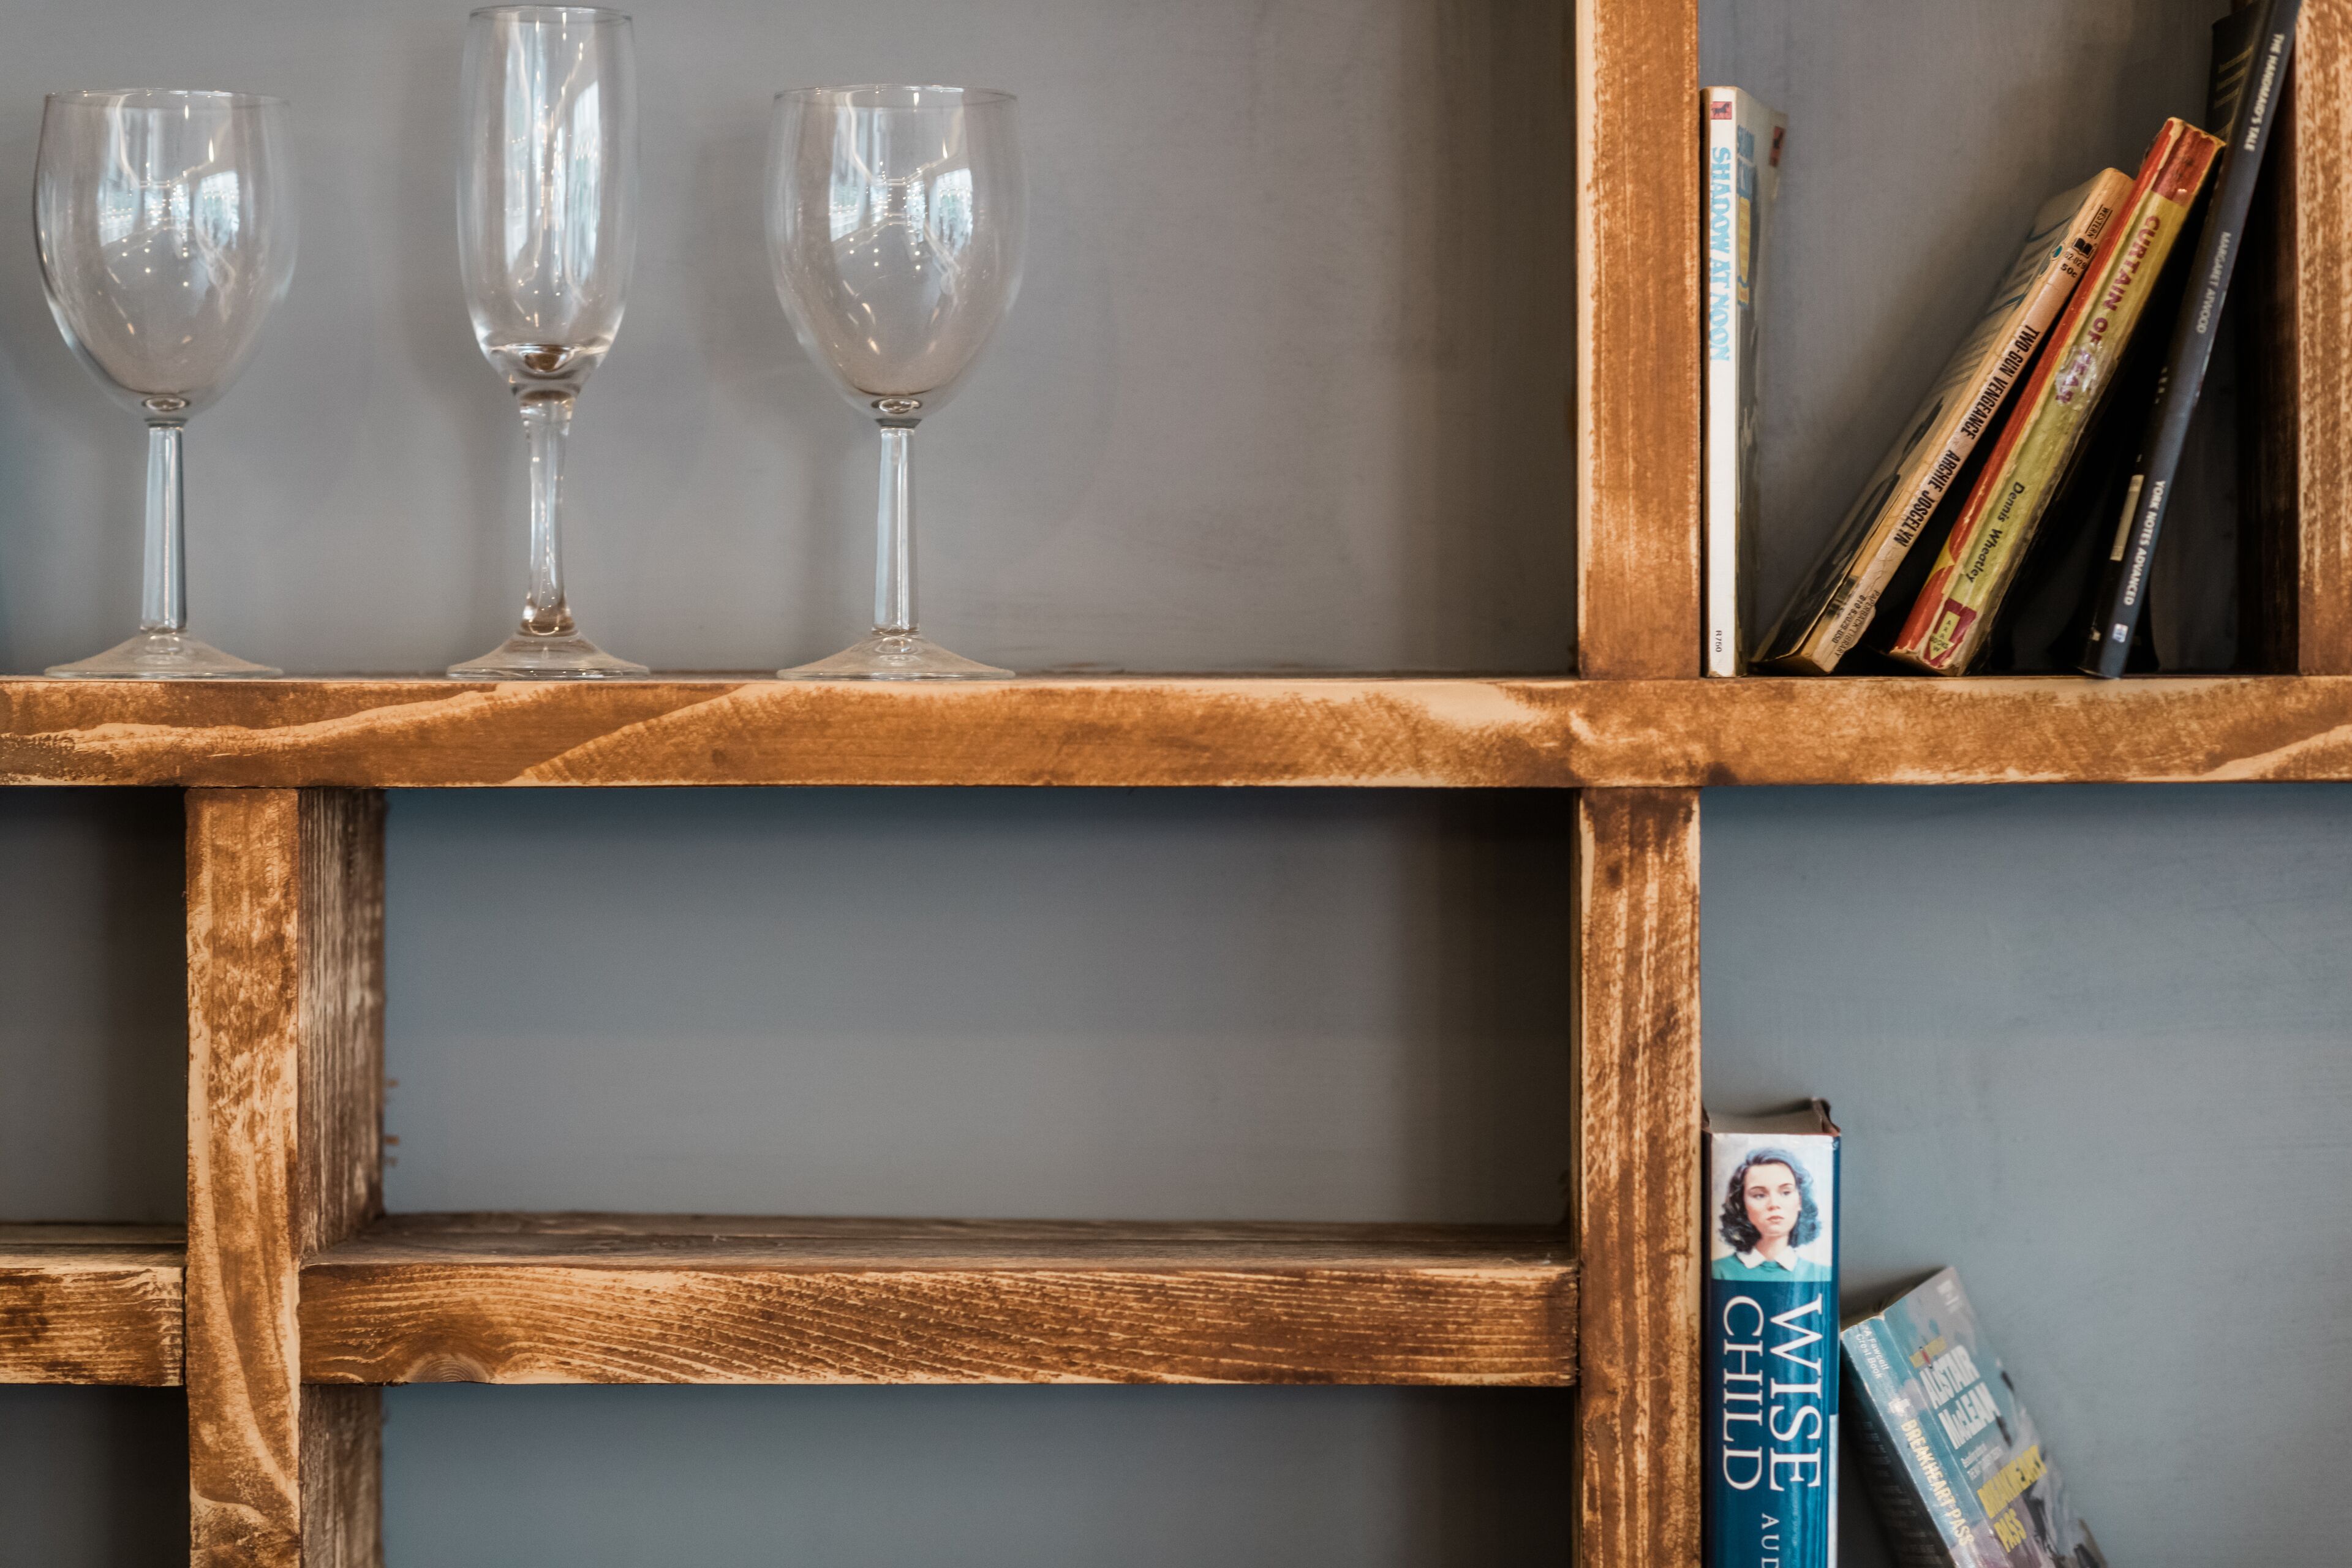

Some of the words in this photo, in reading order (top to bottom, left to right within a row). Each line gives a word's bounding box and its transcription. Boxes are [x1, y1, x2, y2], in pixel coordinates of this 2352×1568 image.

[2270, 33, 2285, 54] THE
[2244, 126, 2260, 153] TALE
[1710, 147, 1732, 255] SHADOW
[2087, 207, 2109, 238] WESTERN
[1709, 256, 1732, 290] AT
[2103, 216, 2160, 311] CURTAIN
[2210, 232, 2231, 287] MARGARET
[1709, 293, 1730, 362] NOON
[2088, 317, 2108, 345] OF
[2196, 287, 2216, 334] ATWOOD
[1999, 325, 2040, 378] TWO-GUN
[1961, 376, 2008, 440] VENGEANCE
[1928, 450, 1961, 493] ARCHIE
[2149, 480, 2166, 510] YORK
[1893, 489, 1936, 548] JOSCELYN
[1997, 481, 2026, 522] Dennis
[2139, 510, 2158, 546] NOTES
[1966, 529, 2003, 583] Wheatley
[2123, 547, 2147, 606] ADVANCED
[1854, 589, 1880, 627] PAPERBACK
[1723, 1295, 1764, 1490] CHILD
[1769, 1293, 1823, 1492] WISE
[1868, 1357, 1883, 1379] Book
[1919, 1344, 1981, 1409] ALISTAIR
[1901, 1419, 1956, 1507] BREAKHEART
[1945, 1508, 1975, 1547] PASS
[1994, 1508, 2027, 1553] PASS
